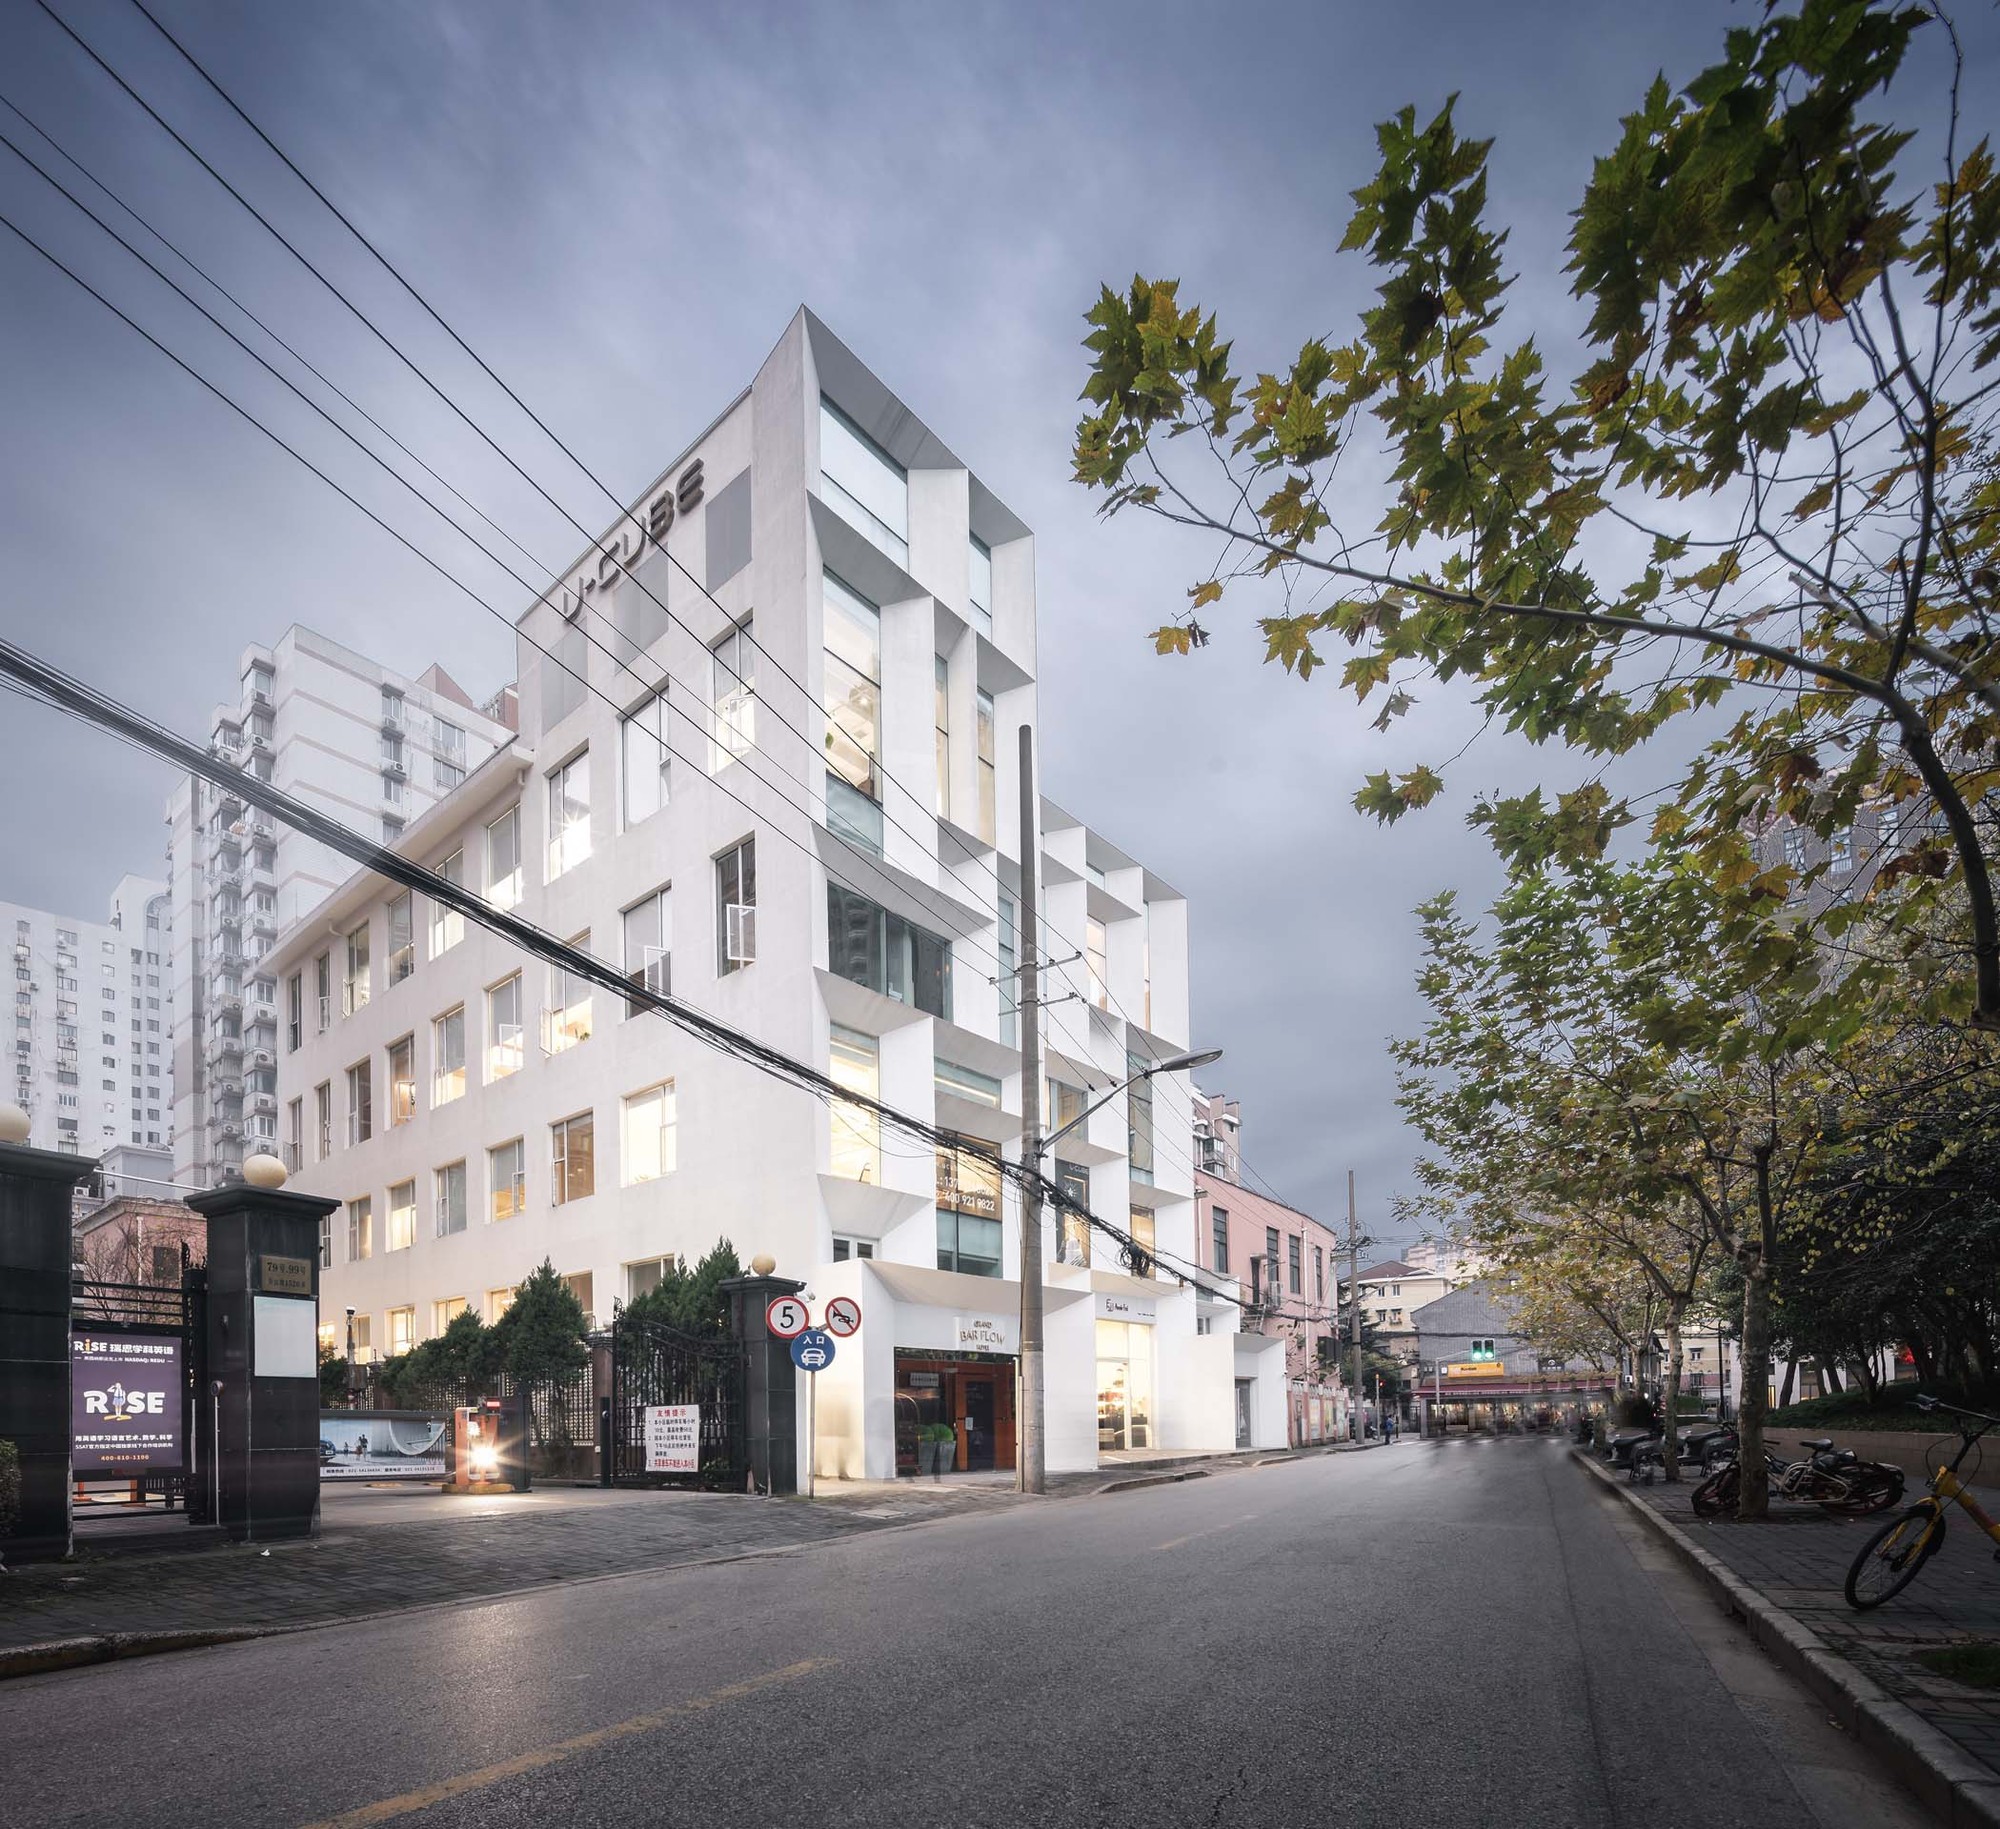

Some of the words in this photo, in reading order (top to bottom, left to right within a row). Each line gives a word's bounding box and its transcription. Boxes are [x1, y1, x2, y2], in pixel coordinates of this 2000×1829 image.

[780, 1306, 795, 1329] 5
[803, 1335, 825, 1345] 入口
[960, 1330, 978, 1342] BAR
[980, 1330, 1005, 1346] FLOW
[657, 1409, 686, 1417] 友情提示
